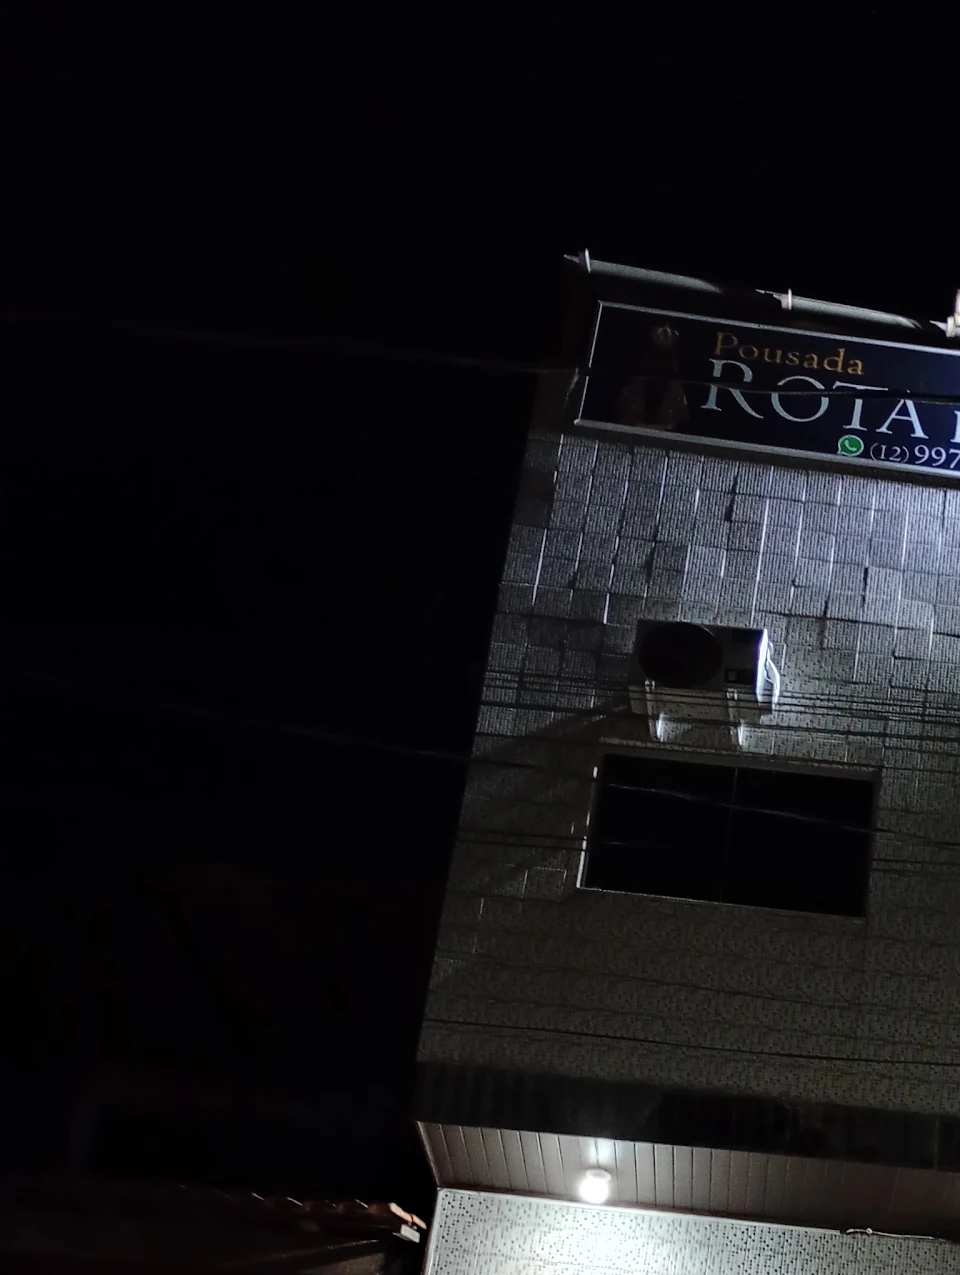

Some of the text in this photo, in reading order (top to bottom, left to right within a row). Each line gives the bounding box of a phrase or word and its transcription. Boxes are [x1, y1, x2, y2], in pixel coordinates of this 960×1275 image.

[715, 331, 865, 377] Pousada
[700, 358, 930, 440] ROTA
[870, 442, 910, 464] (12)
